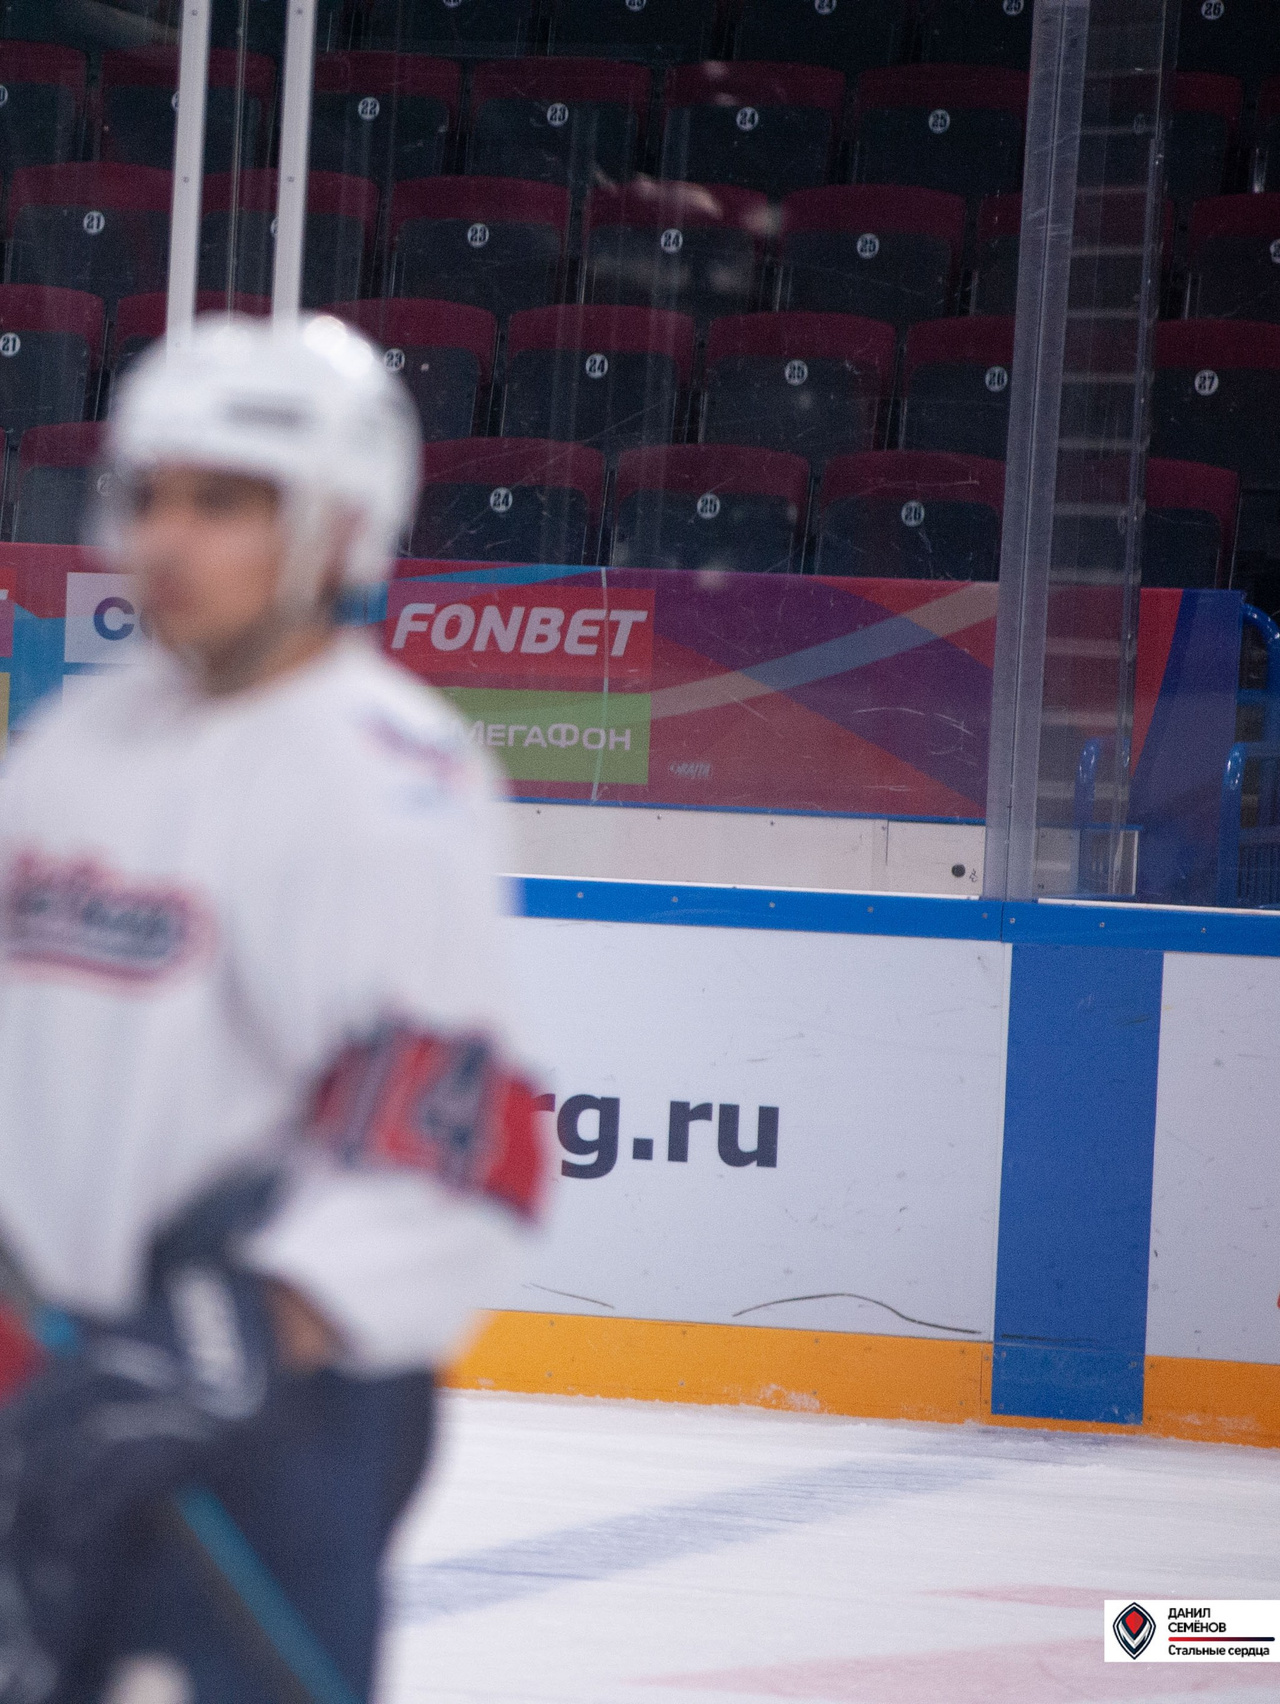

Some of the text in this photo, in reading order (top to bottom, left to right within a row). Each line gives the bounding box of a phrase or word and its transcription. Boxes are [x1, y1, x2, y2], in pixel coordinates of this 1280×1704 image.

[1204, 2, 1220, 15] 26
[361, 100, 377, 115] 22
[550, 106, 566, 121] 23
[740, 112, 755, 126] 24
[87, 215, 101, 229] 21
[470, 228, 486, 242] 23
[664, 233, 679, 247] 24
[2, 337, 16, 351] 21
[387, 353, 402, 367] 23
[589, 358, 605, 373] 24
[1198, 375, 1215, 389] 27
[493, 492, 509, 507] 24
[700, 498, 716, 513] 25
[905, 506, 921, 520] 26
[391, 603, 648, 657] FONBET
